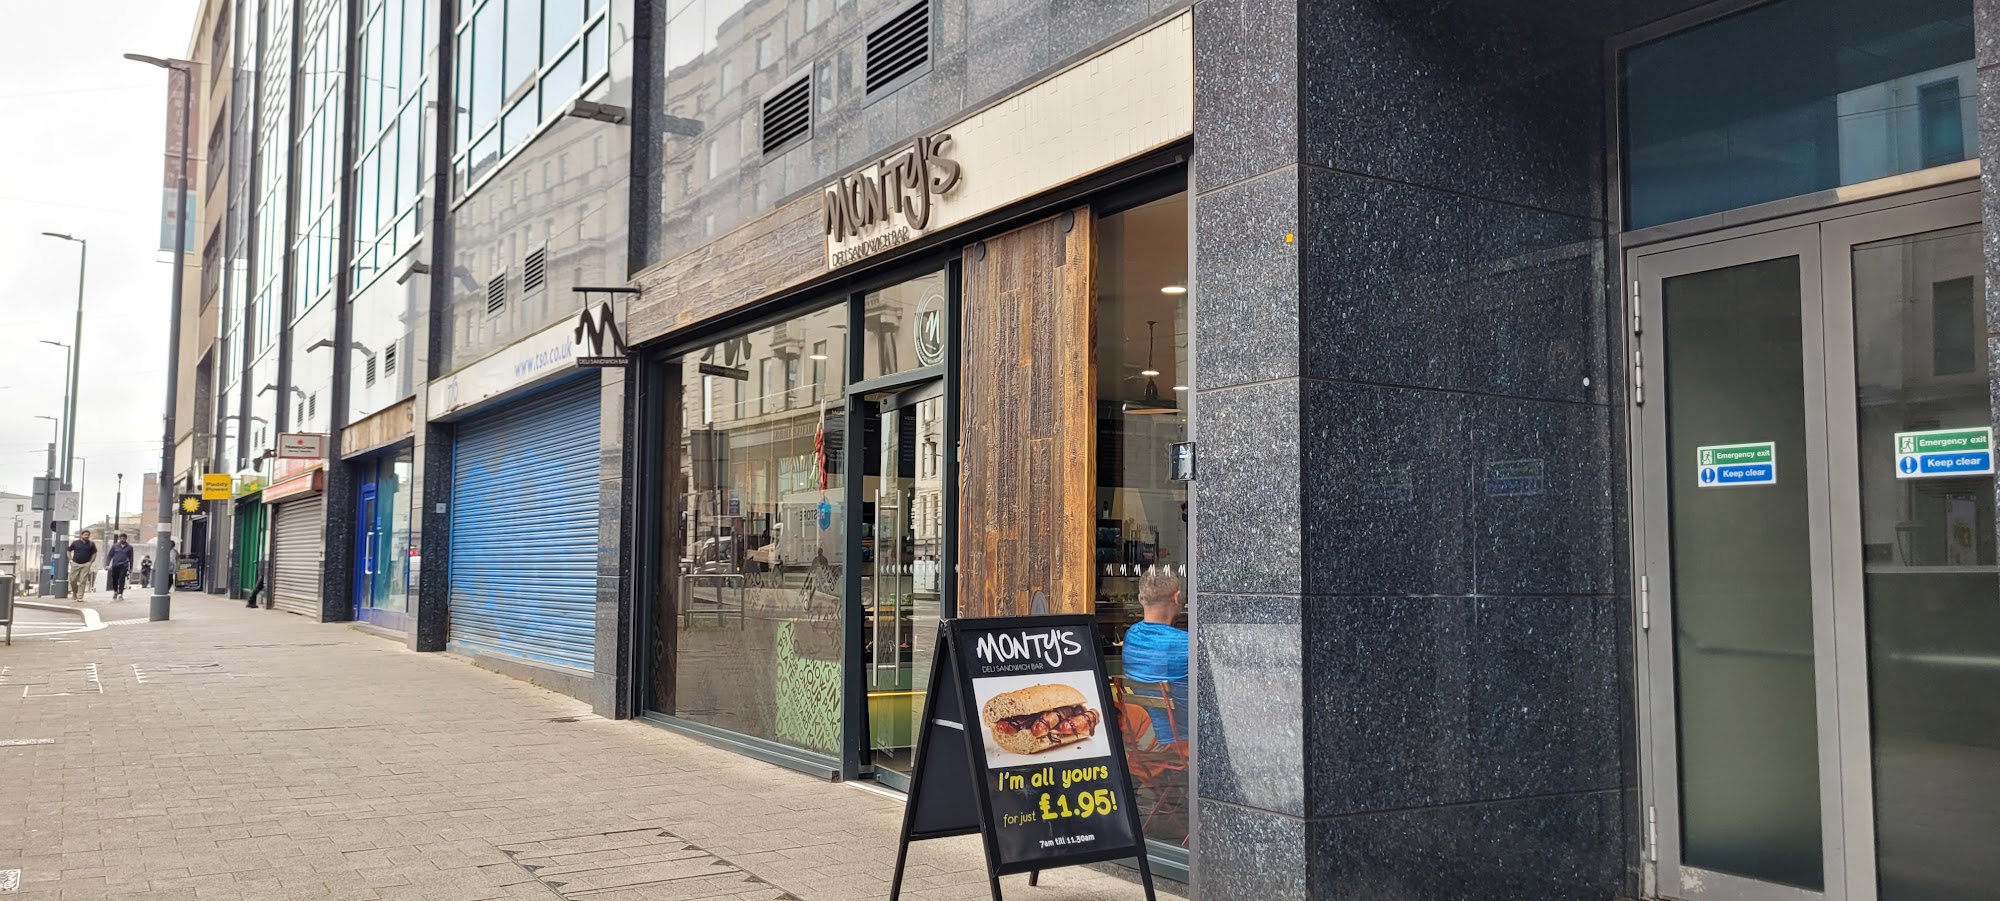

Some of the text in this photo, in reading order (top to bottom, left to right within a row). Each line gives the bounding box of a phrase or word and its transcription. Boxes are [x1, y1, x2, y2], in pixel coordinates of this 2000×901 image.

[825, 134, 961, 242] MONTY'S
[832, 249, 848, 267] DELI
[891, 226, 909, 245] BAR
[514, 336, 572, 377] www.tso.co.uk
[1716, 449, 1770, 460] Emergency exit
[1920, 435, 1986, 448] Emergency exit
[1722, 468, 1766, 480] Keep clear
[1927, 456, 1982, 469] Keep clear
[777, 638, 795, 682] PLATE
[788, 645, 798, 670] YOUR
[976, 629, 1082, 668] MONTY'S
[996, 664, 1030, 672] SANDWICH
[1031, 662, 1044, 670] BAR
[799, 669, 816, 714] ONIONS
[803, 657, 822, 706] YOUR
[827, 681, 840, 713] IN
[791, 687, 809, 730] MUSTARD
[795, 679, 813, 724] CUT THE
[999, 765, 1108, 791] I'm all yours
[1003, 789, 1118, 828] for just £1.95!
[1039, 840, 1054, 848] 7am
[1055, 836, 1066, 845] till
